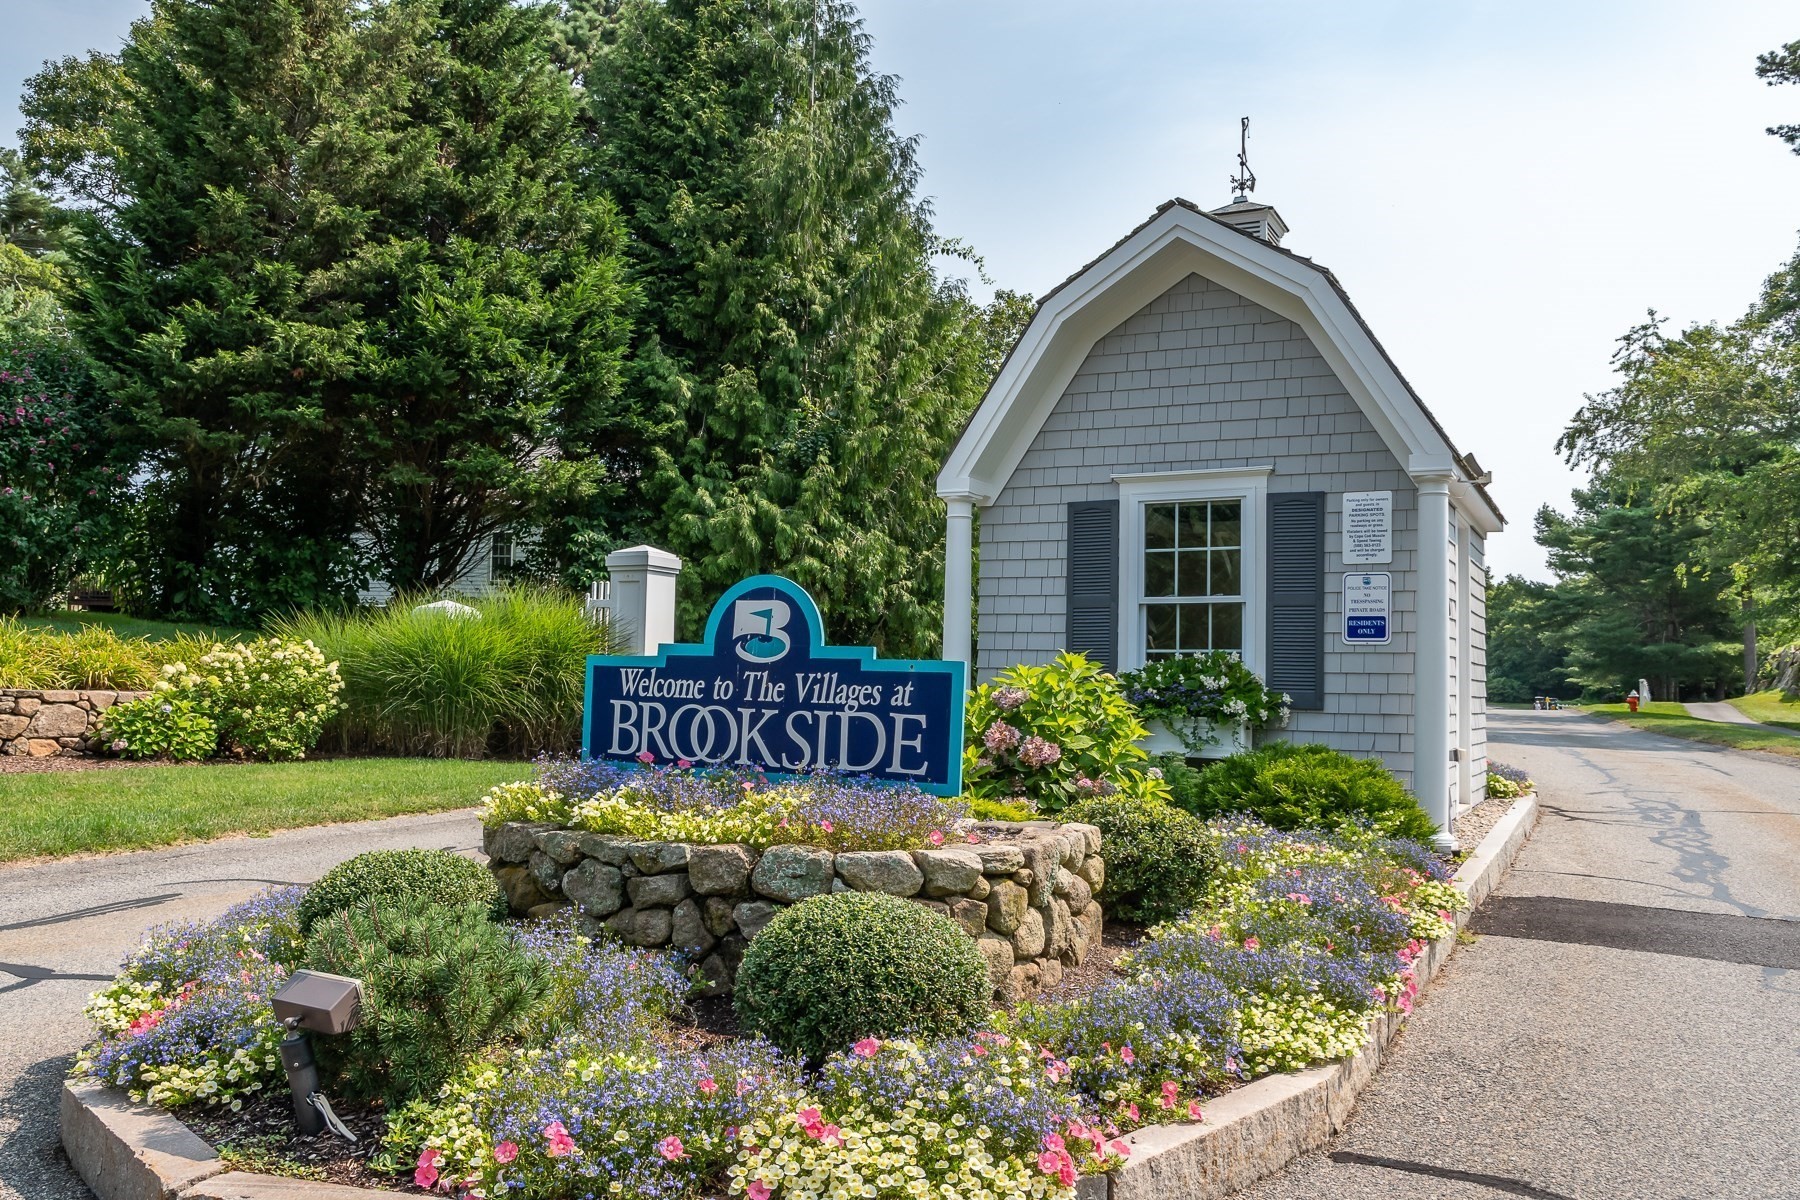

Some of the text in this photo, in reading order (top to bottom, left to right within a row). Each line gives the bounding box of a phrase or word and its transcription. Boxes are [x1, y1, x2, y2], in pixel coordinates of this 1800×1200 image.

[620, 667, 913, 712] Welcome to The Villages at
[608, 699, 928, 775] BROOKSIDE
